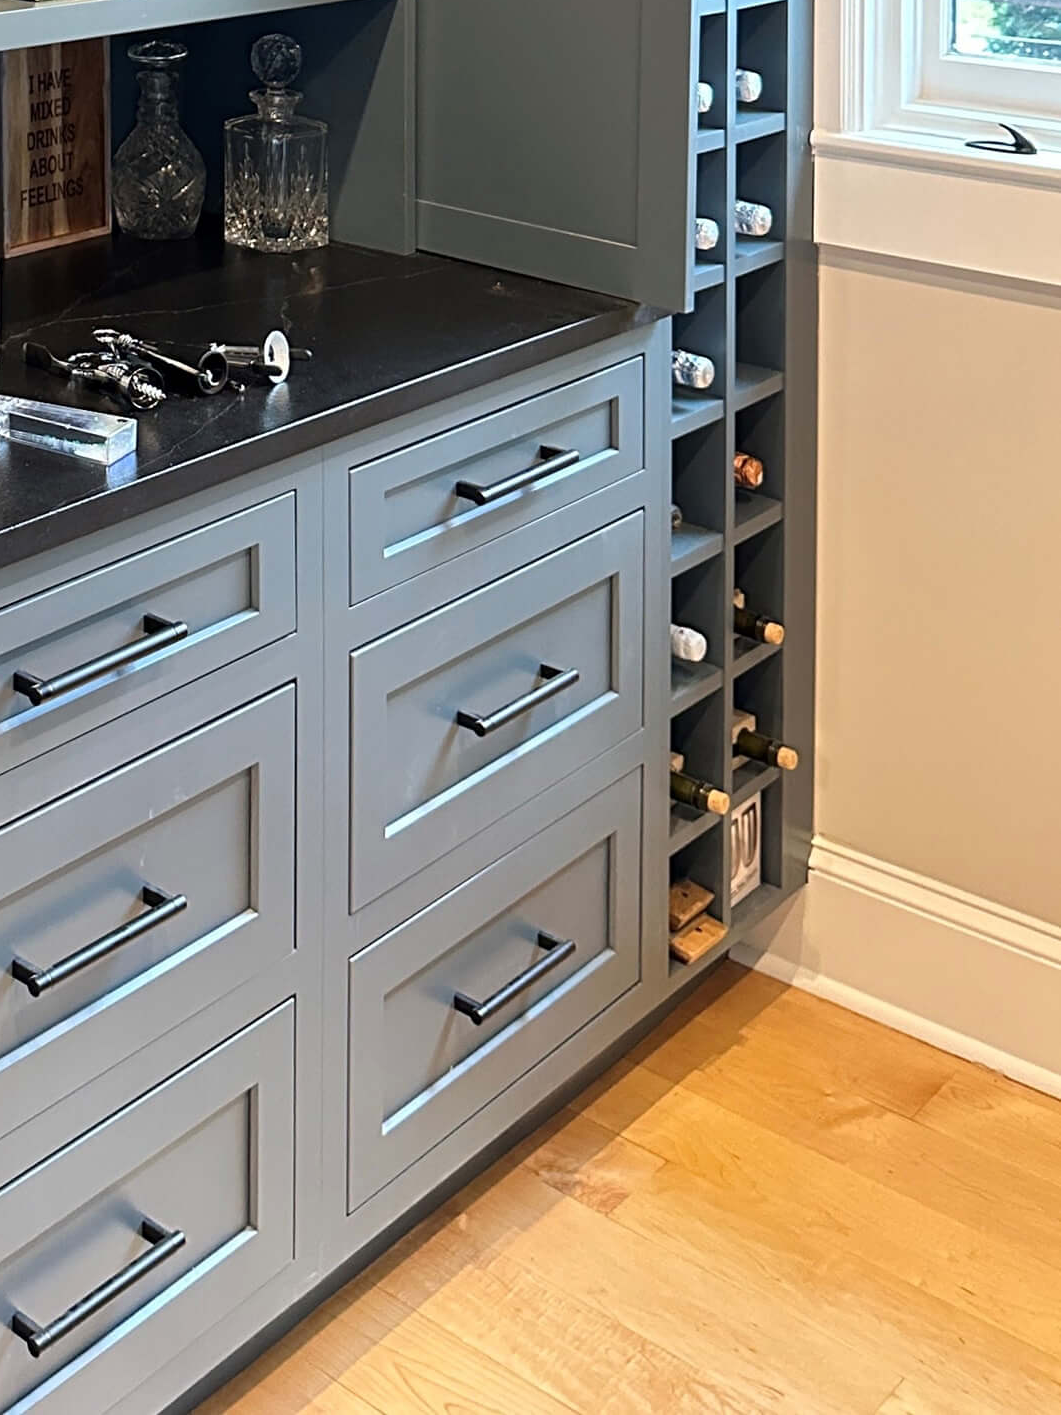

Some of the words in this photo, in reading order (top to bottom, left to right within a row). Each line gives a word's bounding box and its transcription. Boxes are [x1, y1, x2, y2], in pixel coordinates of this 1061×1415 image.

[37, 68, 72, 93] HAVE
[30, 96, 72, 123] MIXED
[26, 123, 76, 151] DRINKS
[29, 151, 74, 179] ABOUT
[20, 176, 84, 211] FEELINGS
